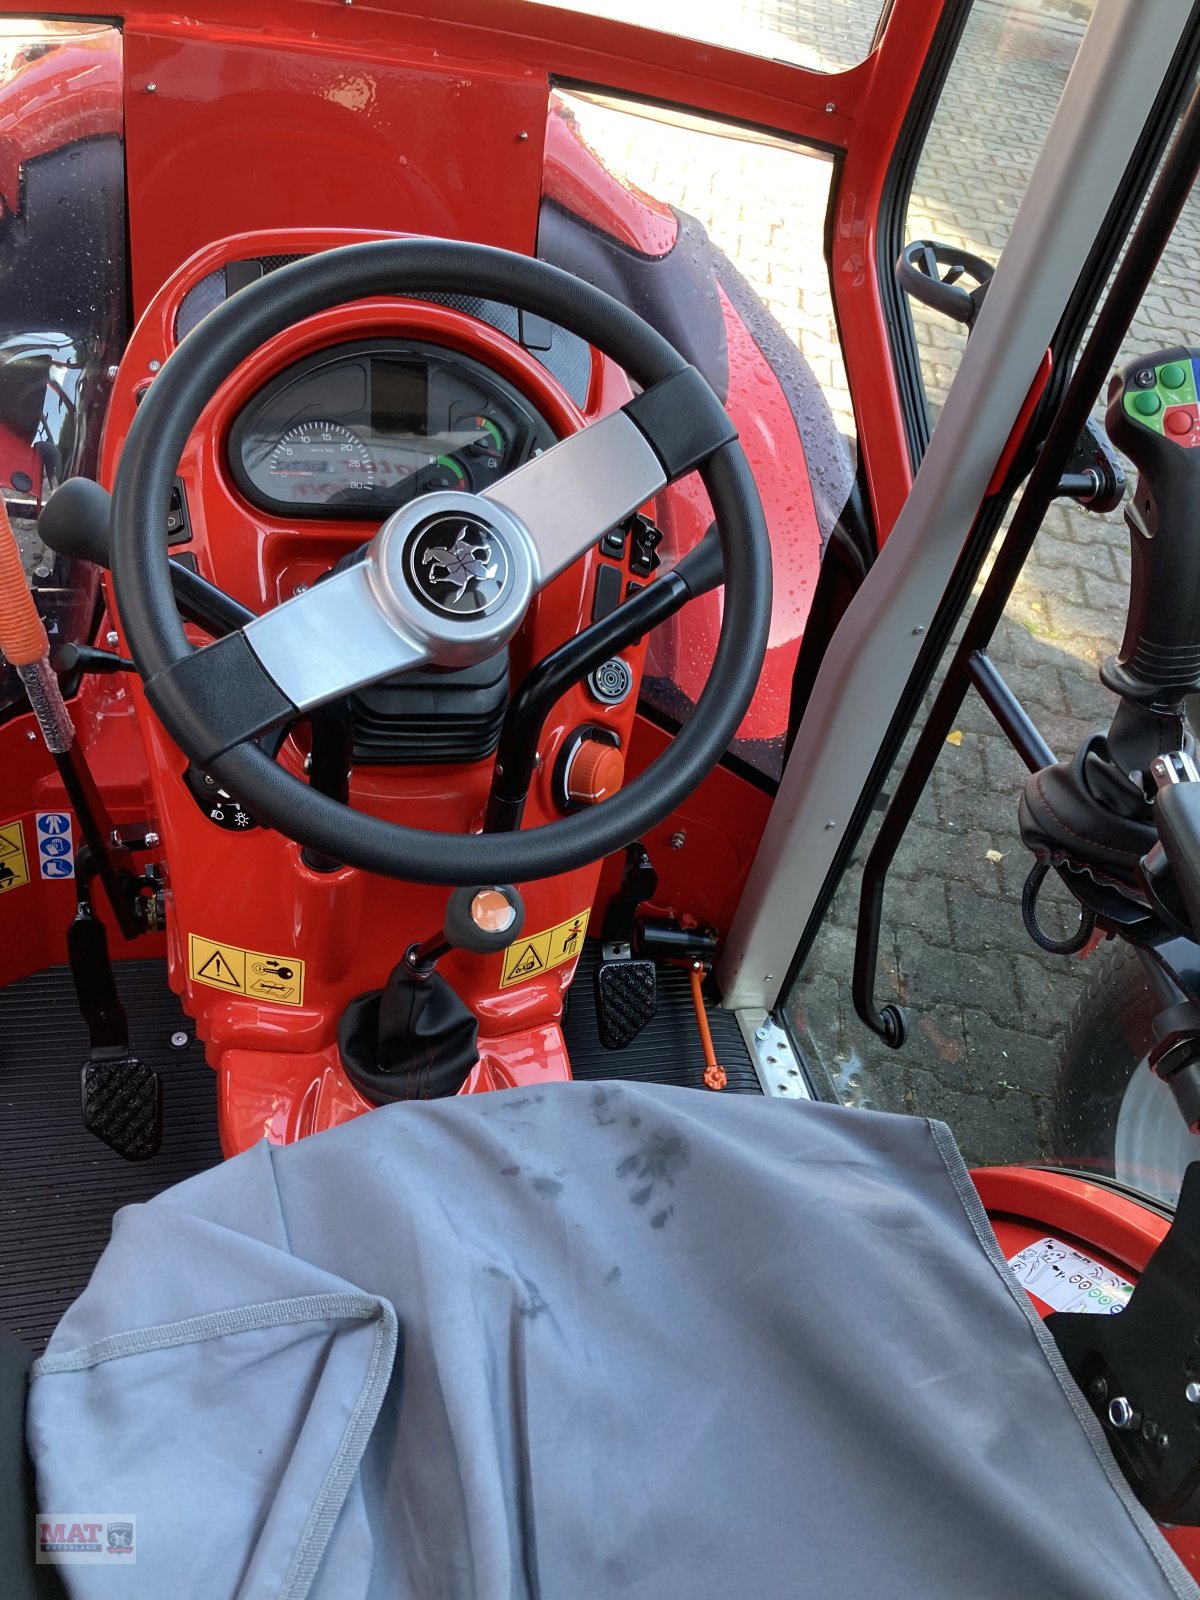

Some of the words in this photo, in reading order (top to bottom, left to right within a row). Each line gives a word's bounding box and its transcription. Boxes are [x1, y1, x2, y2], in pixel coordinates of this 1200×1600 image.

[299, 436, 311, 444] 10
[321, 433, 332, 441] 15
[340, 443, 353, 452] 20
[286, 448, 294, 456] 5
[348, 459, 361, 468] 25
[350, 481, 363, 489] 30
